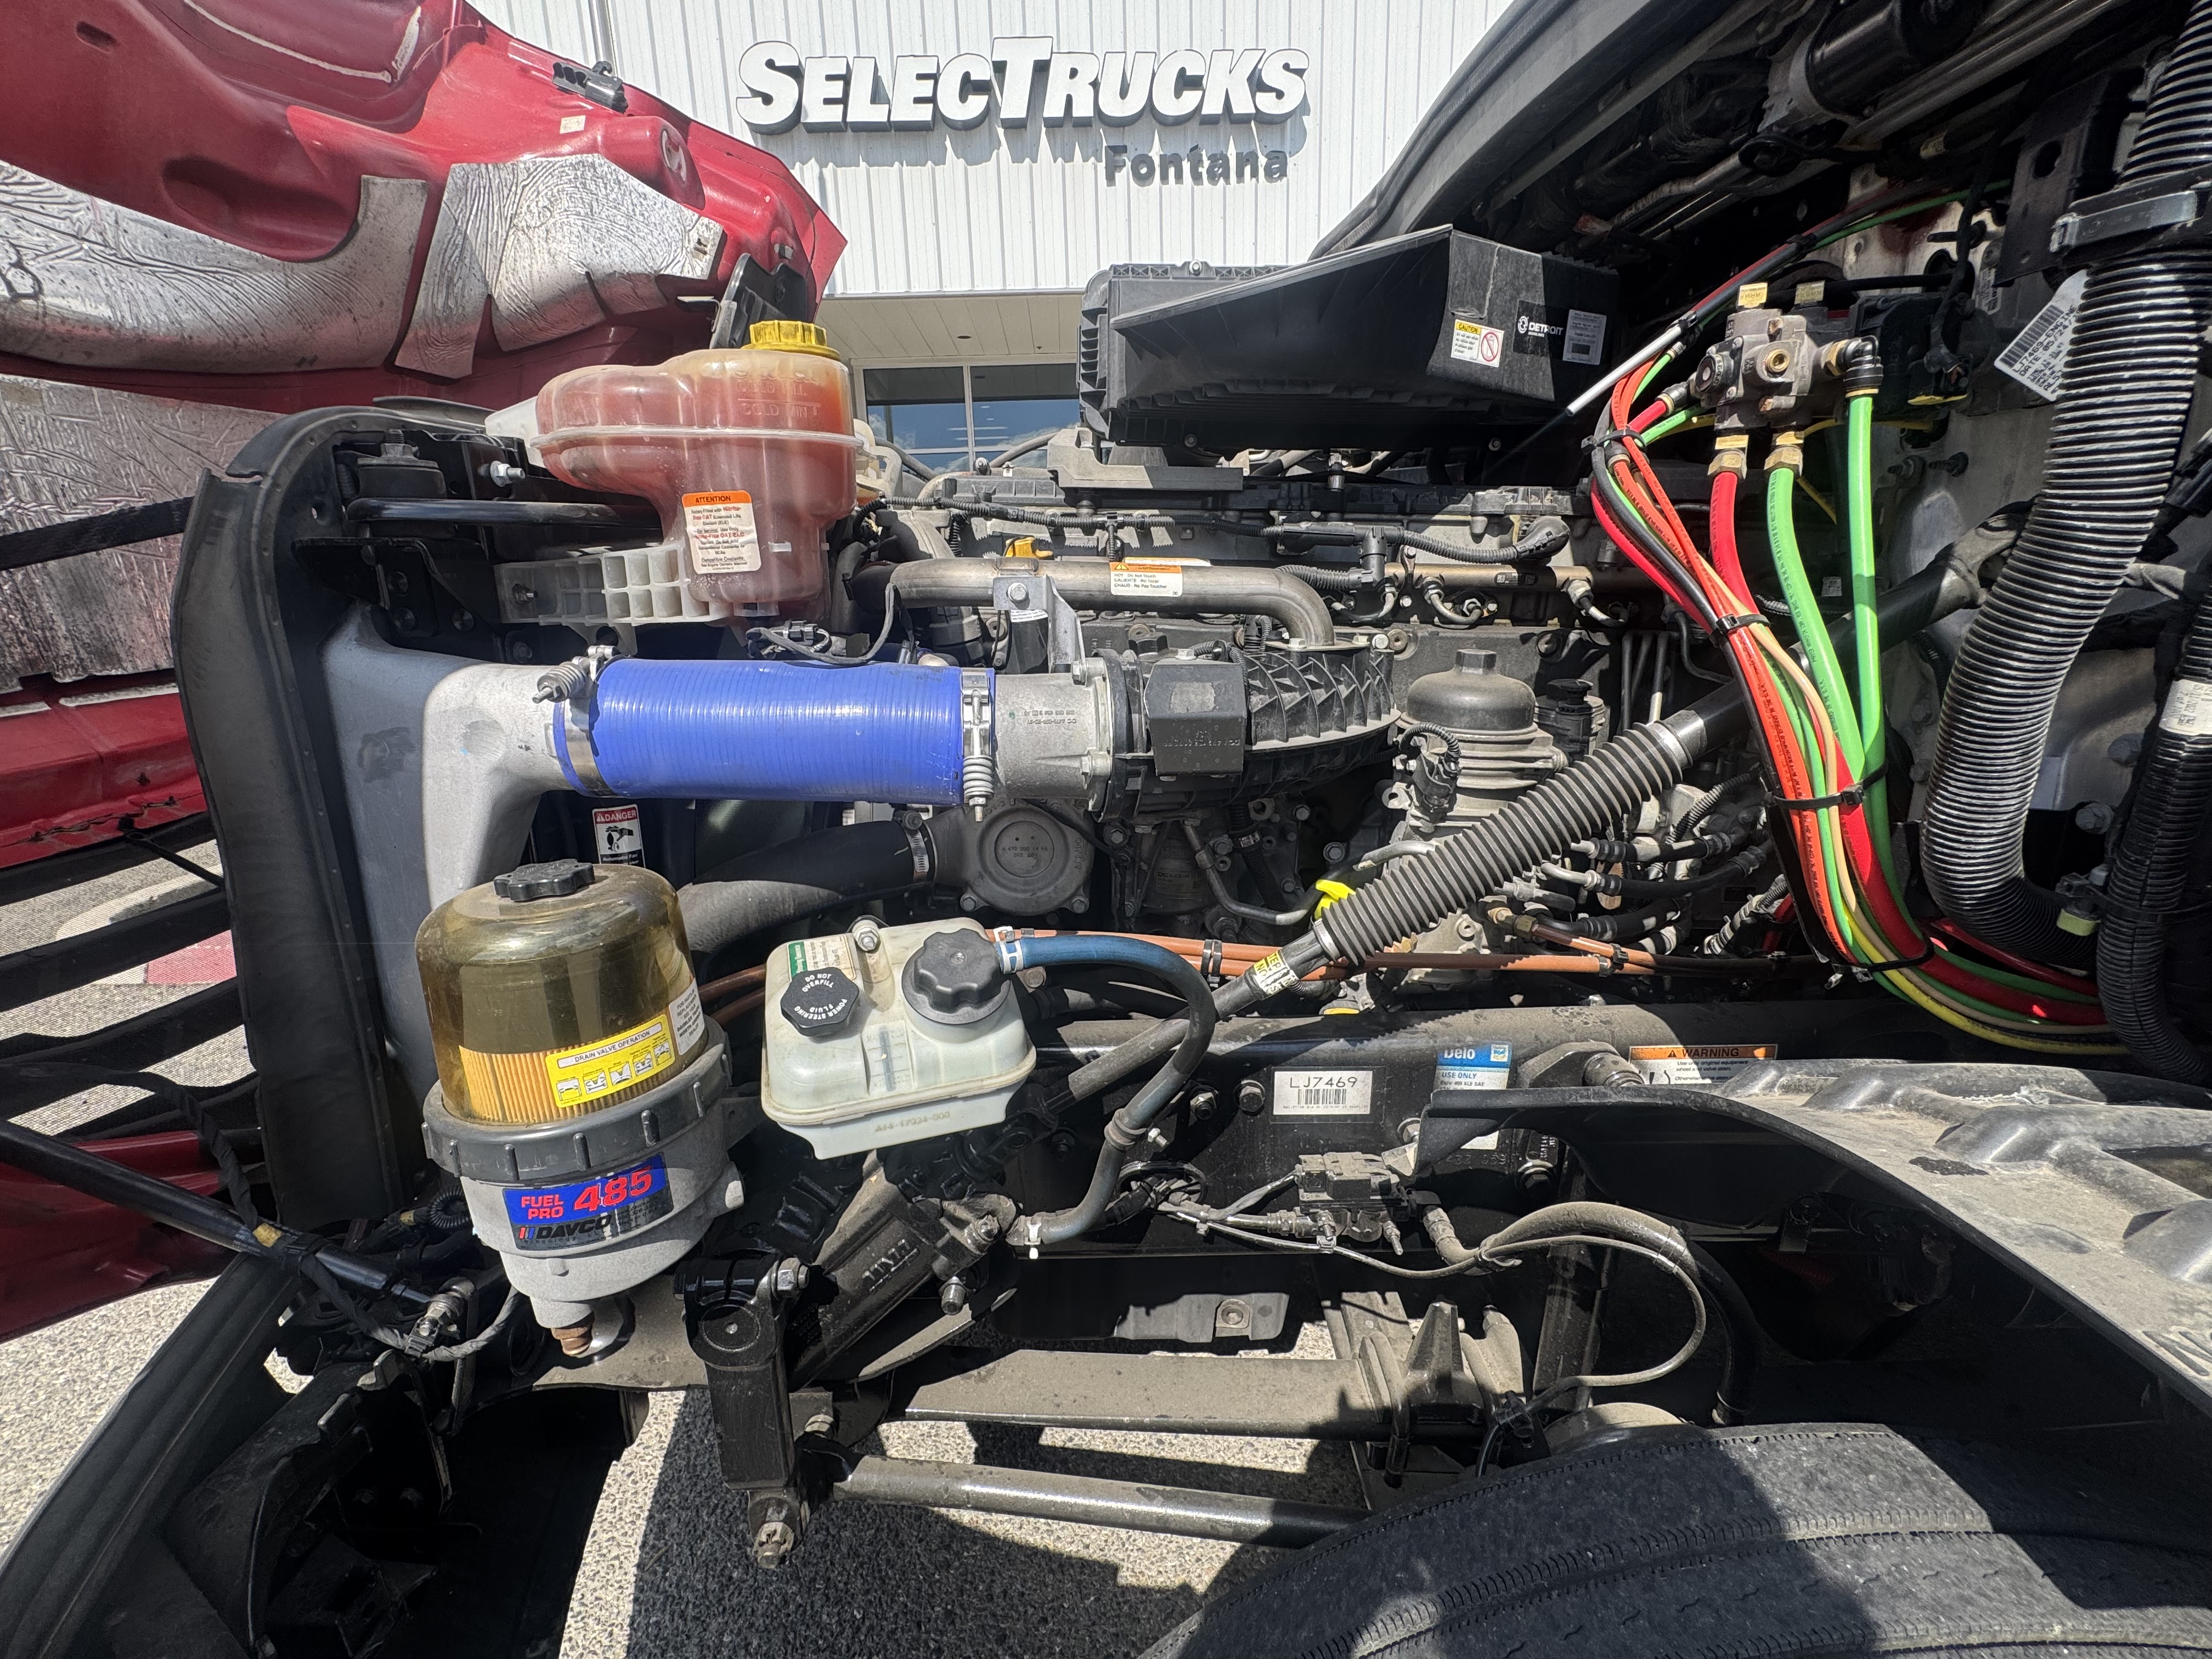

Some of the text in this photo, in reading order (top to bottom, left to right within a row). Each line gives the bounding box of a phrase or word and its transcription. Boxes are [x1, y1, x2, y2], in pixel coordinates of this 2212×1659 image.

[1104, 145, 1288, 186] Fontana
[1459, 323, 1479, 333] CAUTION
[1528, 322, 1564, 336] DETROIT
[695, 495, 731, 504] ATTENTION
[605, 810, 636, 821] DANGER
[804, 974, 815, 983] DO
[802, 979, 834, 992] OVERFILL
[794, 998, 848, 1020] POWER STEERING
[809, 1003, 834, 1013] FLUID
[574, 1053, 595, 1063] DRAIN
[597, 1045, 617, 1056] VALVE
[618, 1030, 650, 1048] OPERATION
[1681, 1048, 1739, 1057] WARNING
[1290, 1076, 1358, 1088] LJ7469
[521, 1164, 652, 1212] FUEL 485
[528, 1206, 564, 1220] PRO
[535, 1214, 613, 1240] DAVCO
